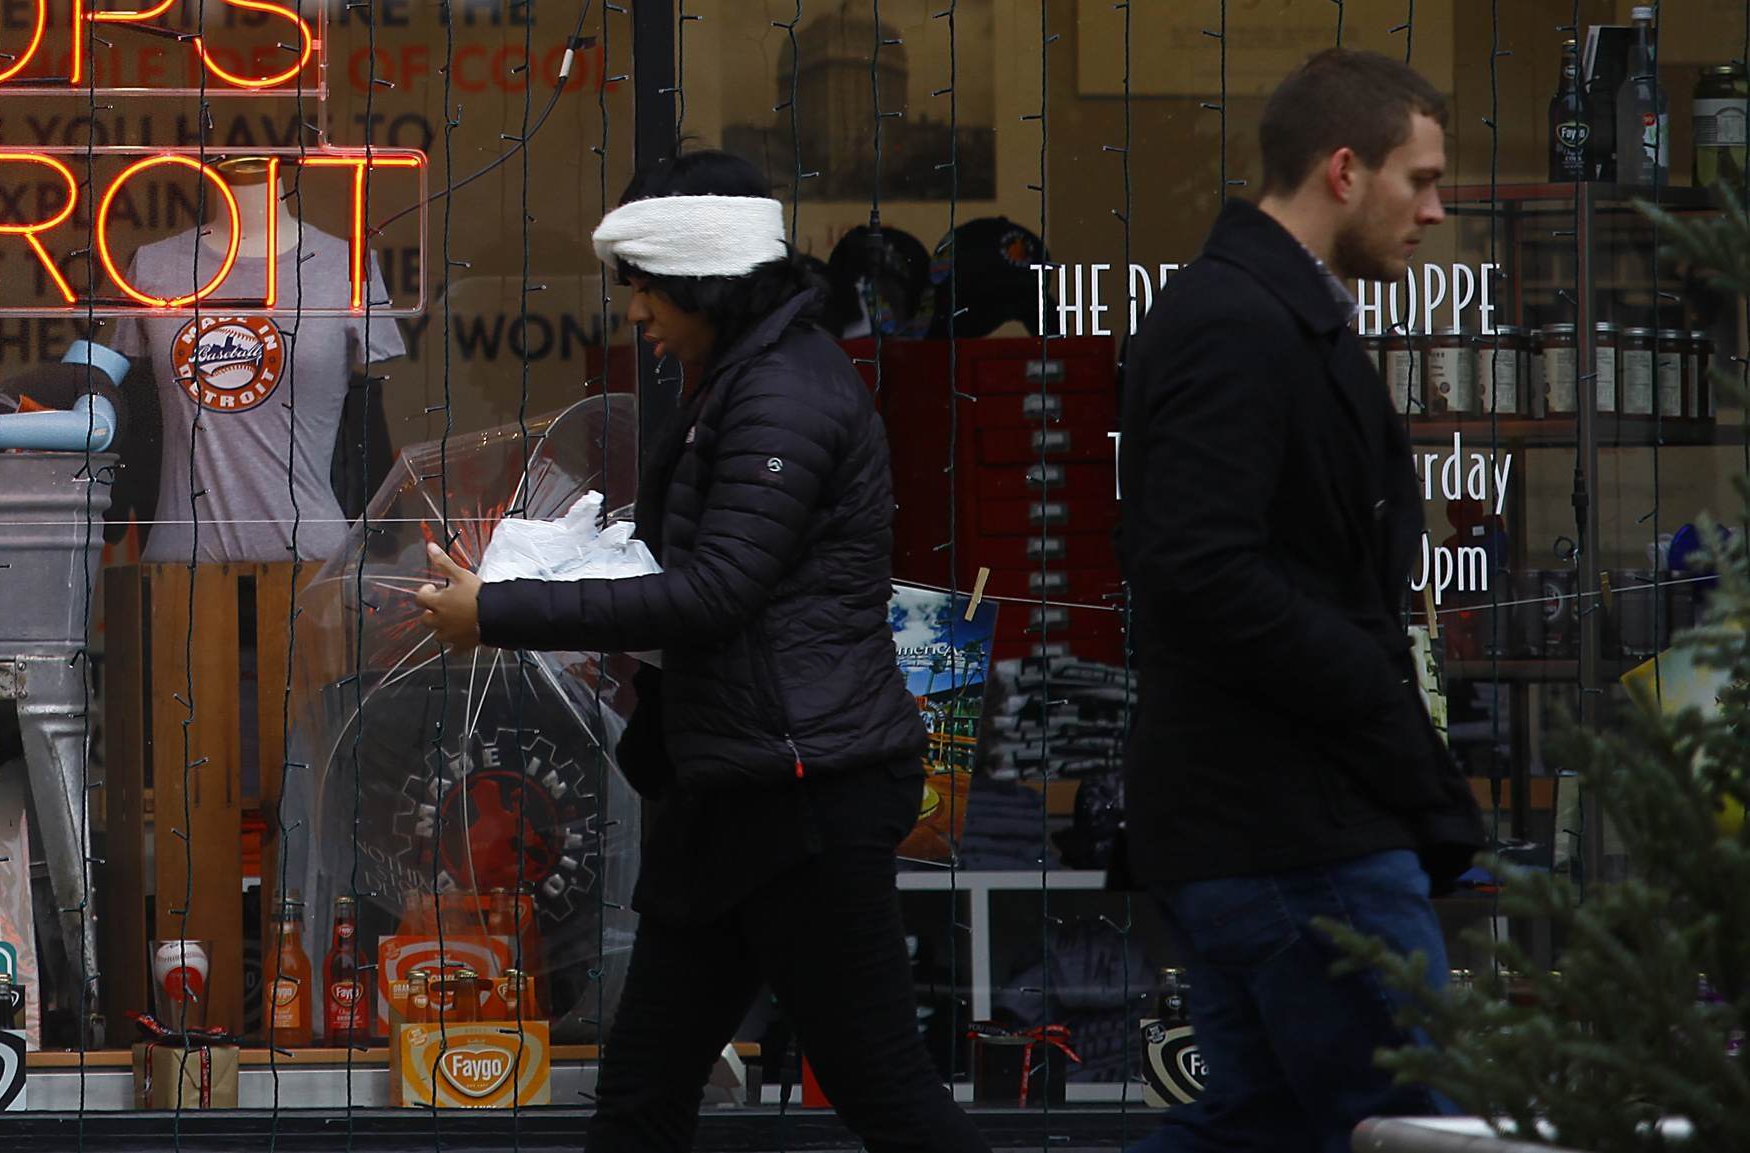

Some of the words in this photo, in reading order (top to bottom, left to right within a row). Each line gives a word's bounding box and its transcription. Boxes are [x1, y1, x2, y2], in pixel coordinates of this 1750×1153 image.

[347, 40, 432, 94] OF
[354, 112, 434, 160] TO
[1561, 127, 1586, 140] Fayo
[1030, 264, 1112, 335] THE
[1357, 264, 1500, 335] HOPPE
[181, 315, 248, 346] MADE
[259, 324, 278, 350] IN
[188, 342, 263, 368] Baseball
[178, 365, 276, 409] DETROIT
[452, 1055, 503, 1081] Faygo
